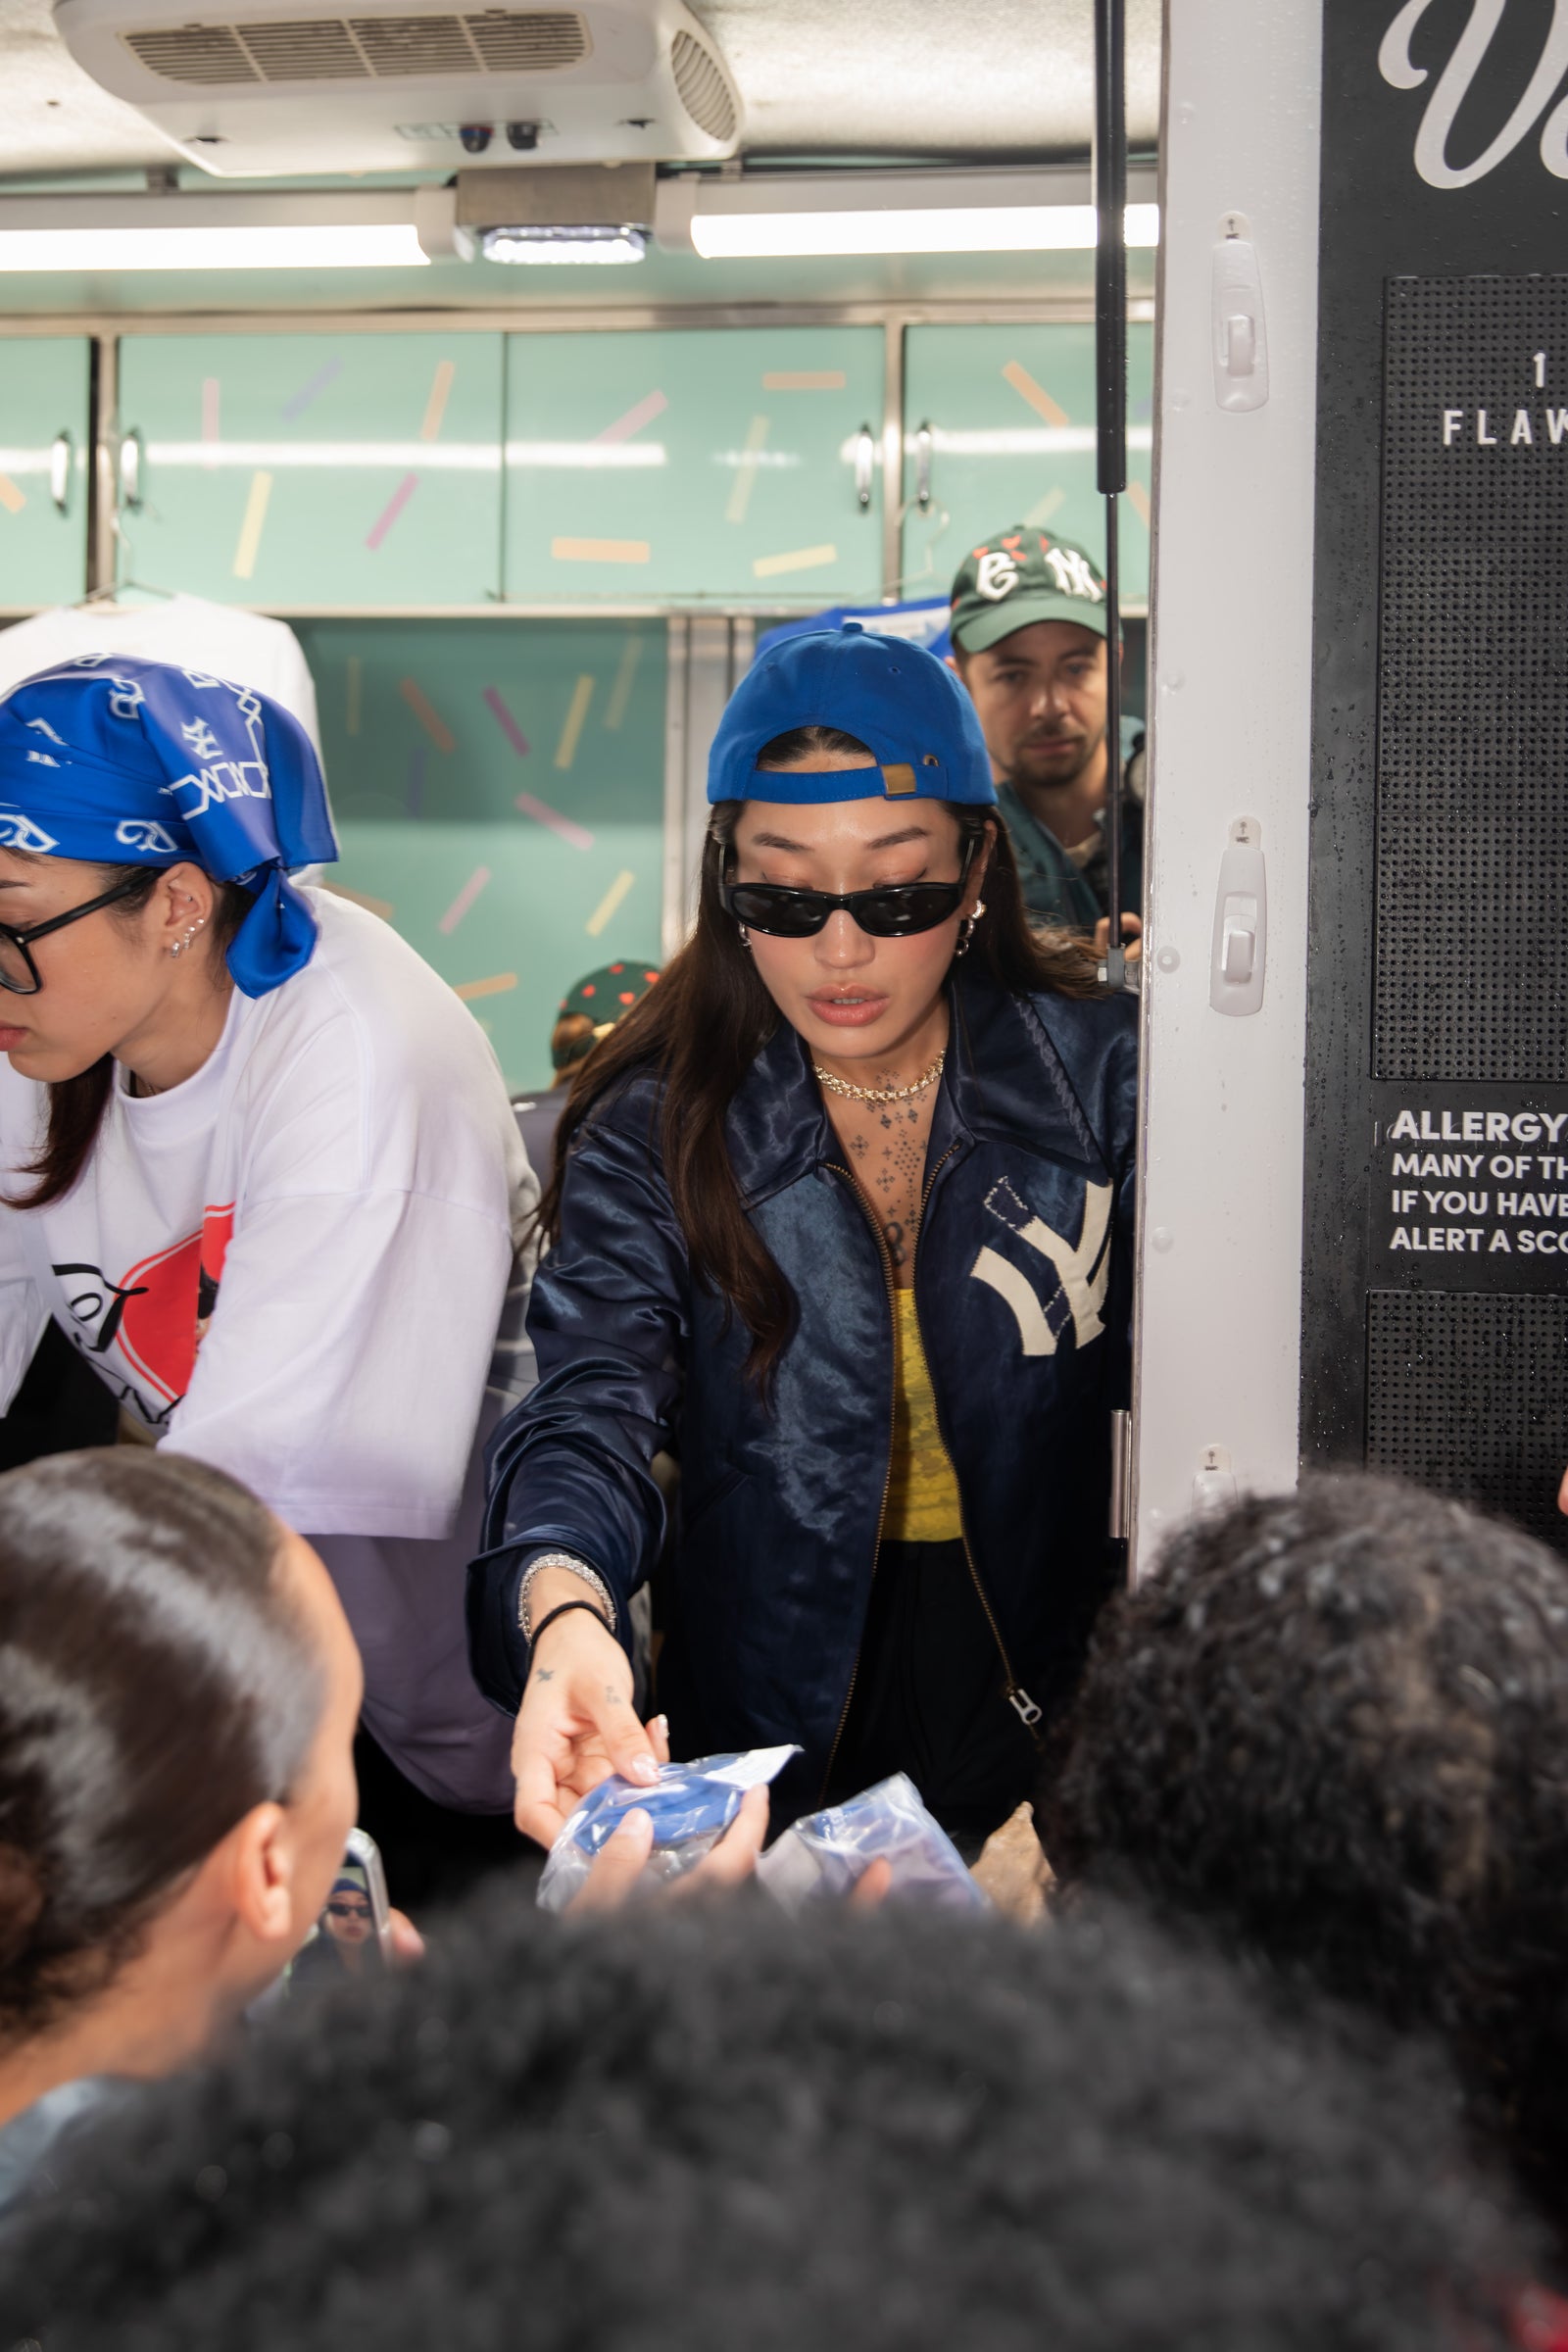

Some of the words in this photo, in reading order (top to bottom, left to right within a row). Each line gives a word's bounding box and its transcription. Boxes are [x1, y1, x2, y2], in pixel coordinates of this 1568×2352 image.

[1533, 352, 1546, 388] 1
[1392, 1109, 1568, 1144] ALLERGY
[1392, 1152, 1485, 1178] MANY
[1490, 1154, 1533, 1180] OF
[1392, 1189, 1419, 1213] IF
[1422, 1191, 1489, 1215] YOU
[1389, 1226, 1485, 1252] ALERT
[1489, 1229, 1512, 1252] A
